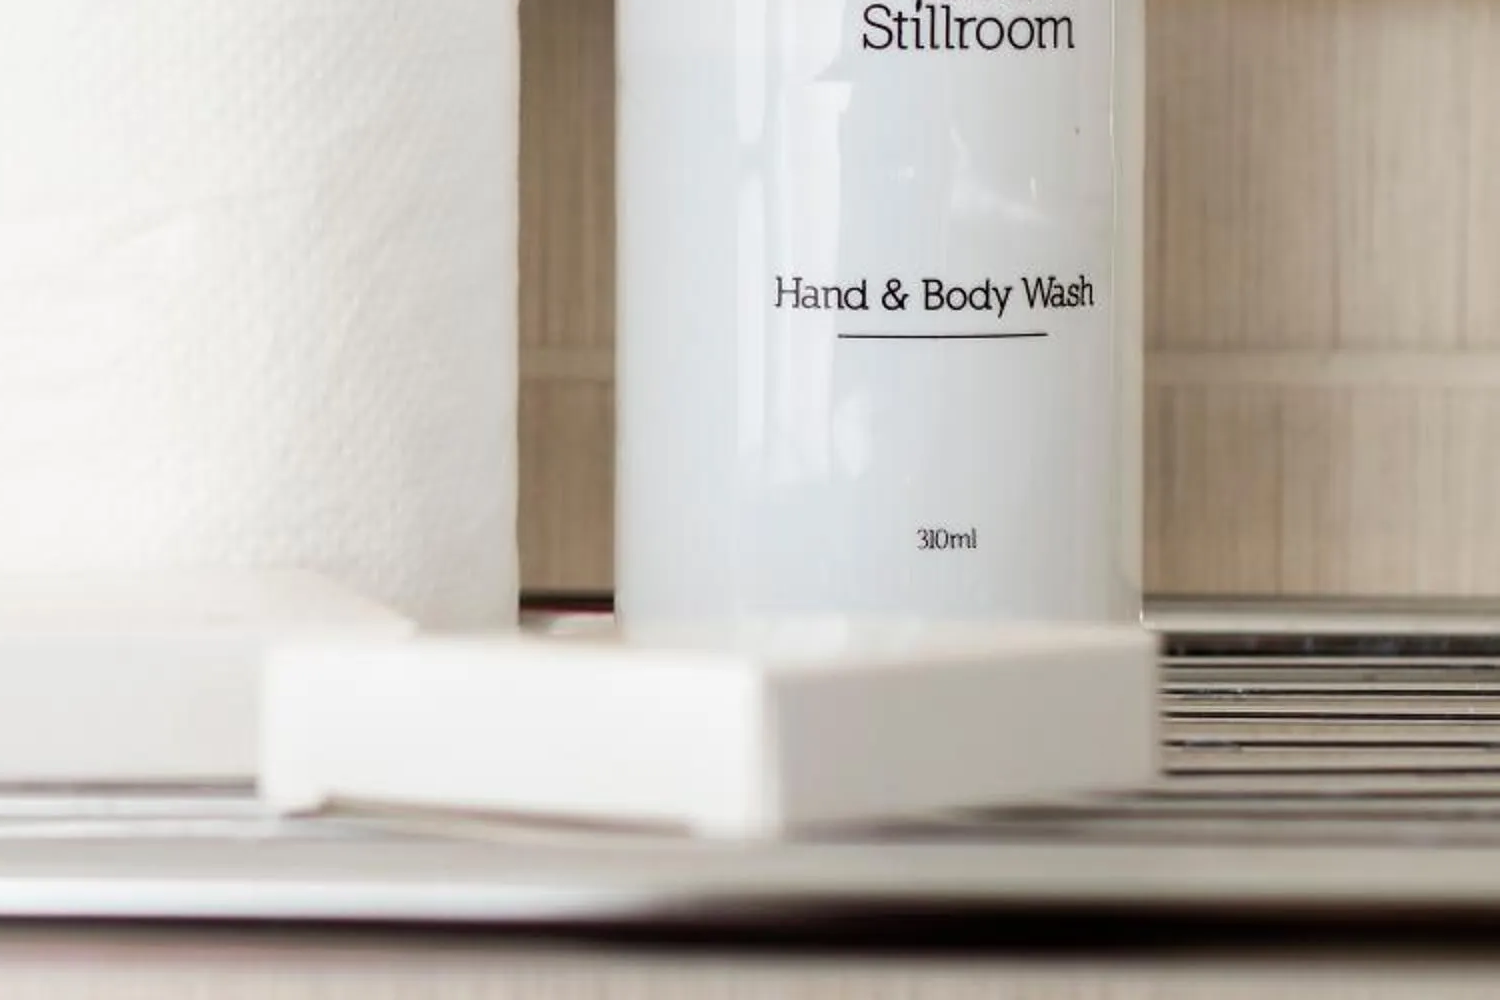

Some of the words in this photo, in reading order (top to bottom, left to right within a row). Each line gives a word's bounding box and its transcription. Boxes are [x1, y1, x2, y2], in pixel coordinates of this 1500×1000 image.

[774, 276, 870, 311] Hand
[881, 277, 911, 312] &
[921, 278, 1013, 319] Body
[1020, 273, 1096, 311] Wash
[916, 528, 978, 551] 310ml
